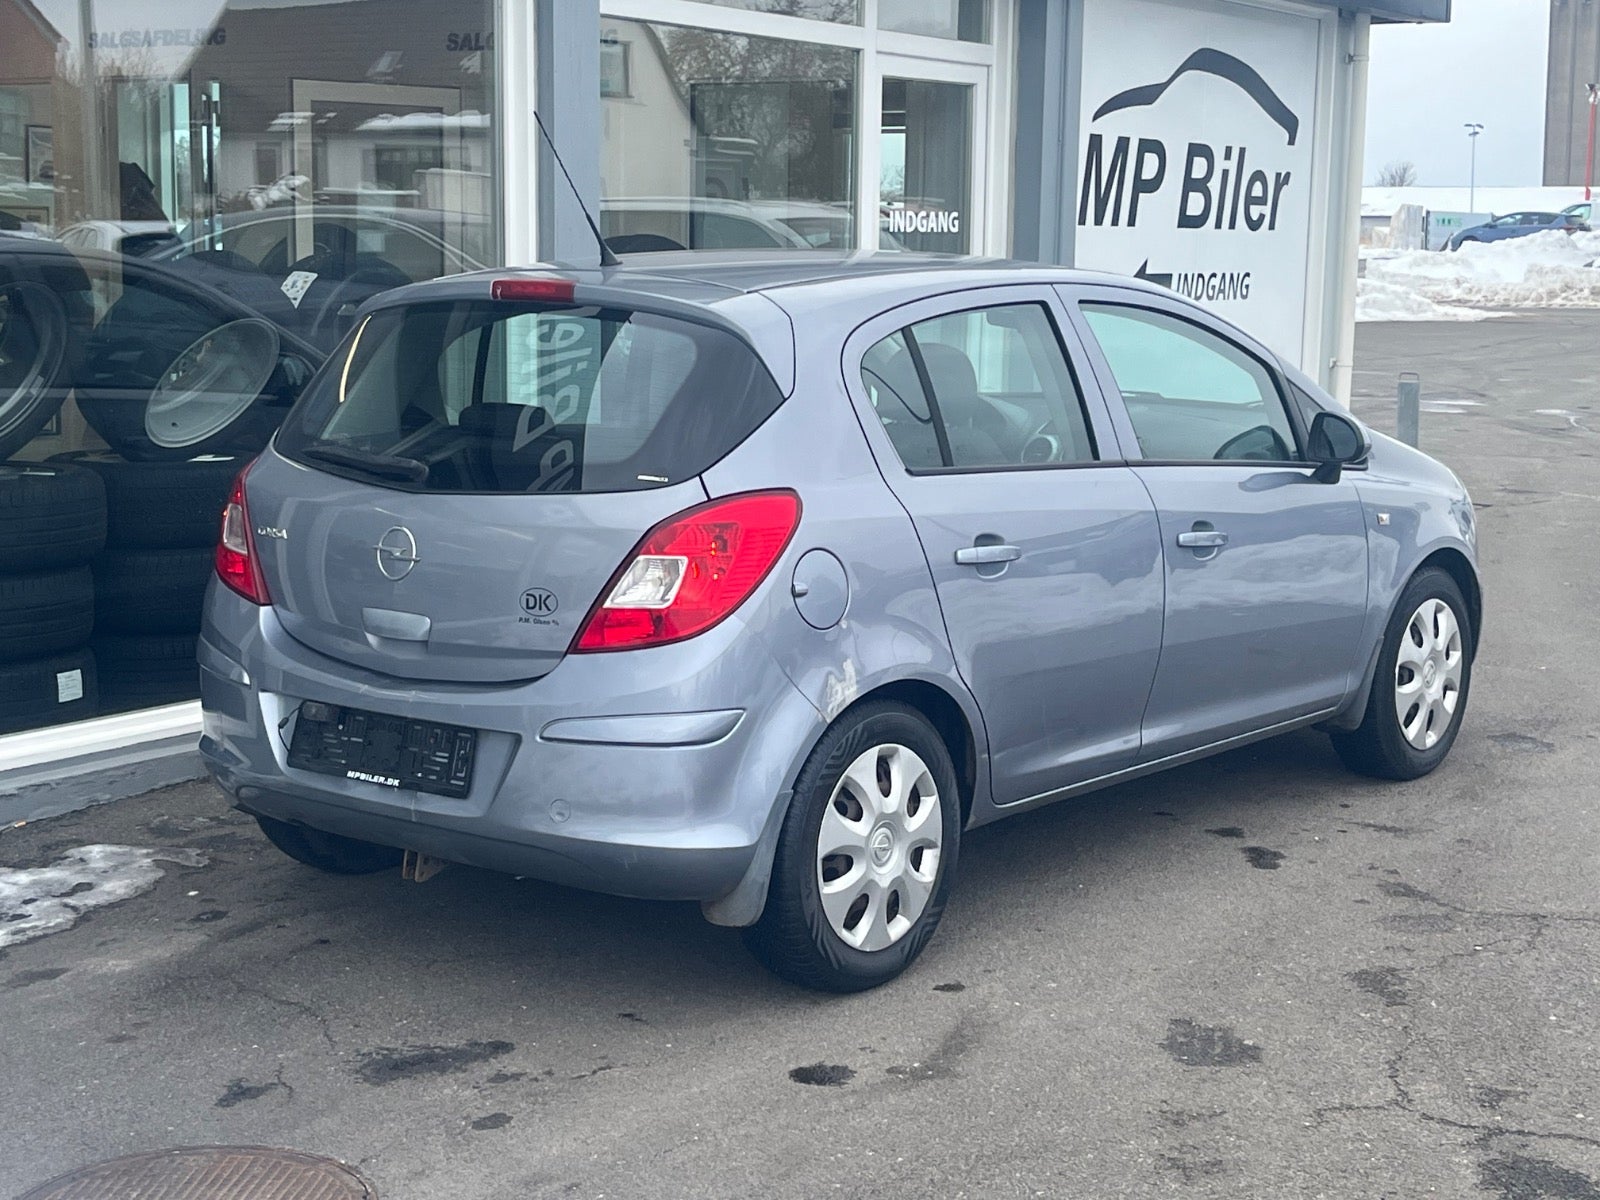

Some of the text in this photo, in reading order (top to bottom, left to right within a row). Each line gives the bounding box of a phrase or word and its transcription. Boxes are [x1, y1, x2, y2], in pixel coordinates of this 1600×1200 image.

[1077, 134, 1291, 231] MP Biler
[888, 210, 960, 233] INDGANG
[1176, 272, 1251, 302] INDGANG
[525, 593, 552, 612] DK
[347, 770, 401, 787] MPBILER.DK
